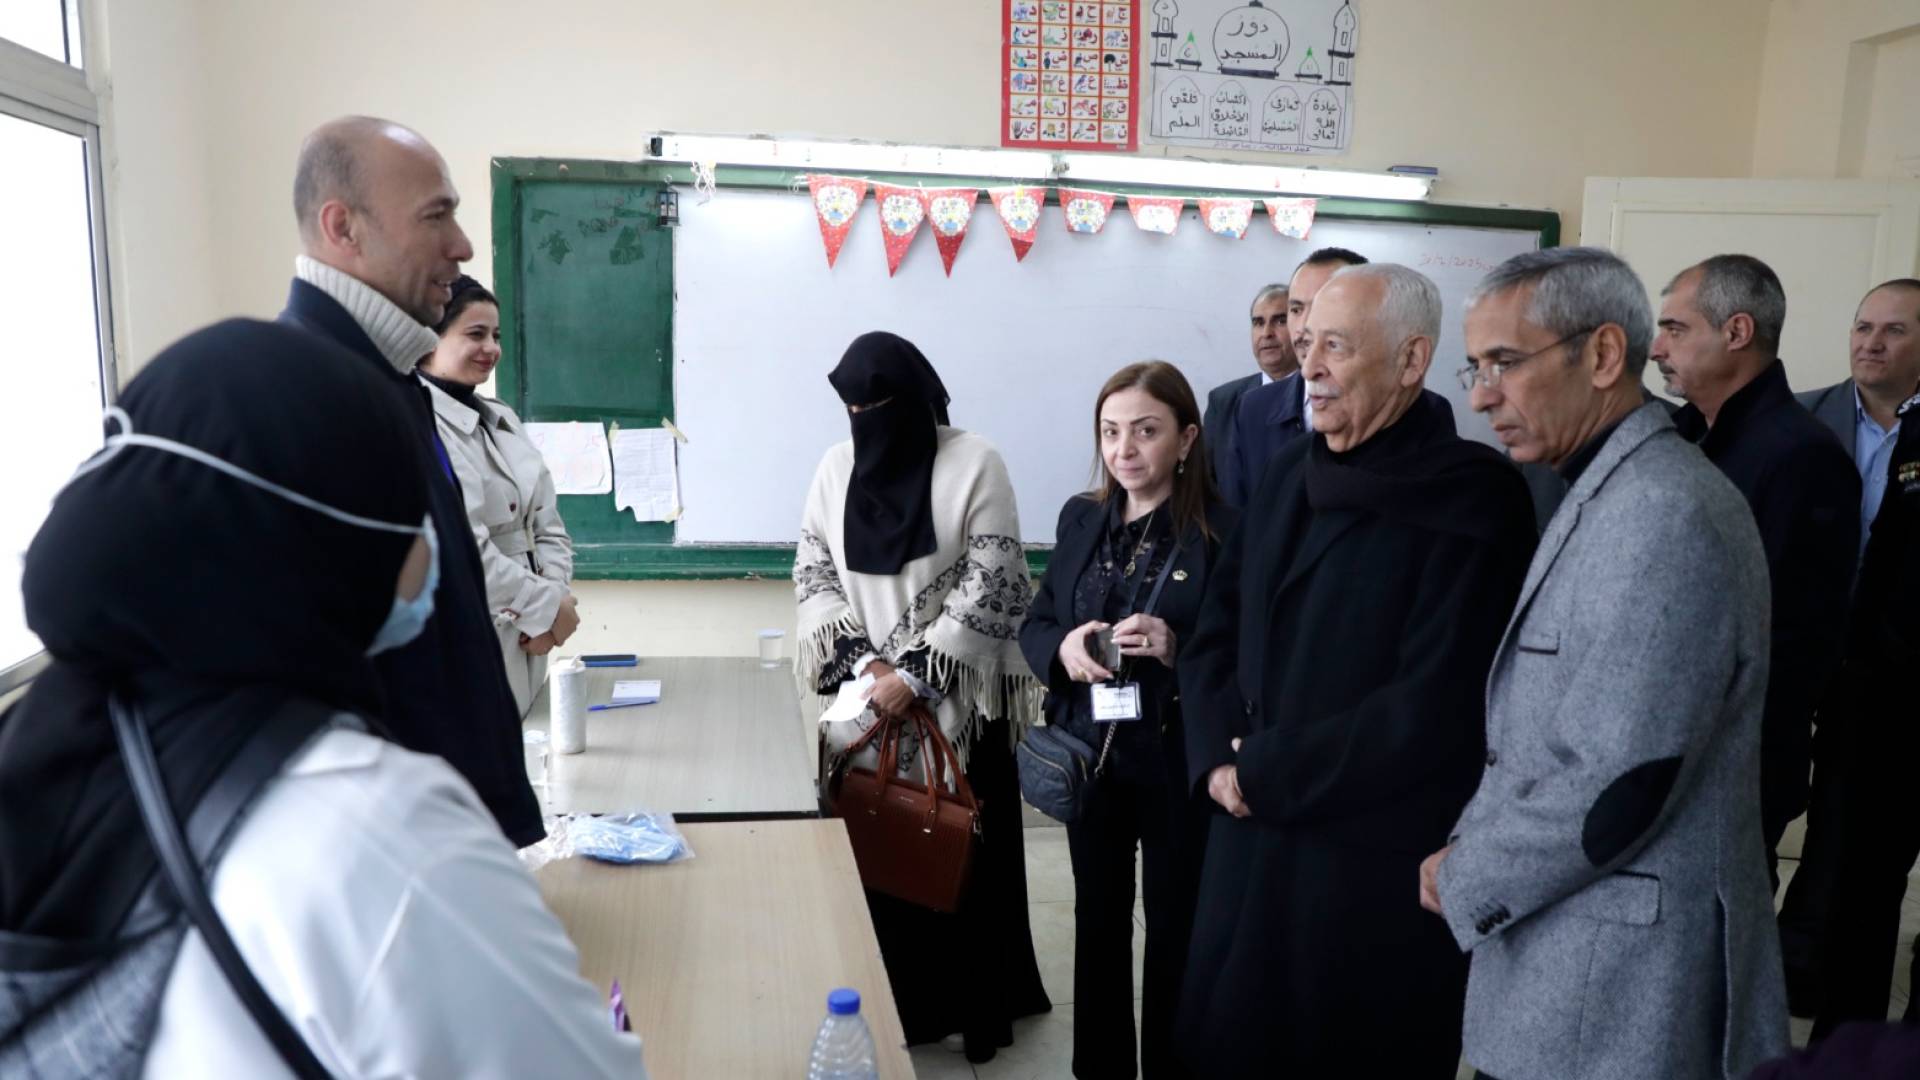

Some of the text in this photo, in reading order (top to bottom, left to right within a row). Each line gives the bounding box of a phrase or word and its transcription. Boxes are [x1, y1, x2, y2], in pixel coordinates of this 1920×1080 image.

[1088, 5, 1097, 18] ح
[1119, 7, 1128, 20] ج
[1022, 28, 1036, 38] س
[1060, 28, 1067, 40] ز
[1088, 34, 1098, 44] ر
[1122, 29, 1128, 42] ذ
[1052, 51, 1067, 64] ض
[1083, 54, 1098, 62] ص
[1220, 43, 1282, 64] المسجد
[1115, 54, 1128, 67] ش
[1058, 76, 1066, 92] غ
[1088, 76, 1096, 90] ع
[1117, 78, 1128, 89] ظ
[1056, 101, 1066, 116] ل
[1117, 100, 1126, 114] ق
[1168, 115, 1200, 132] العلم
[1118, 125, 1127, 138] ن
